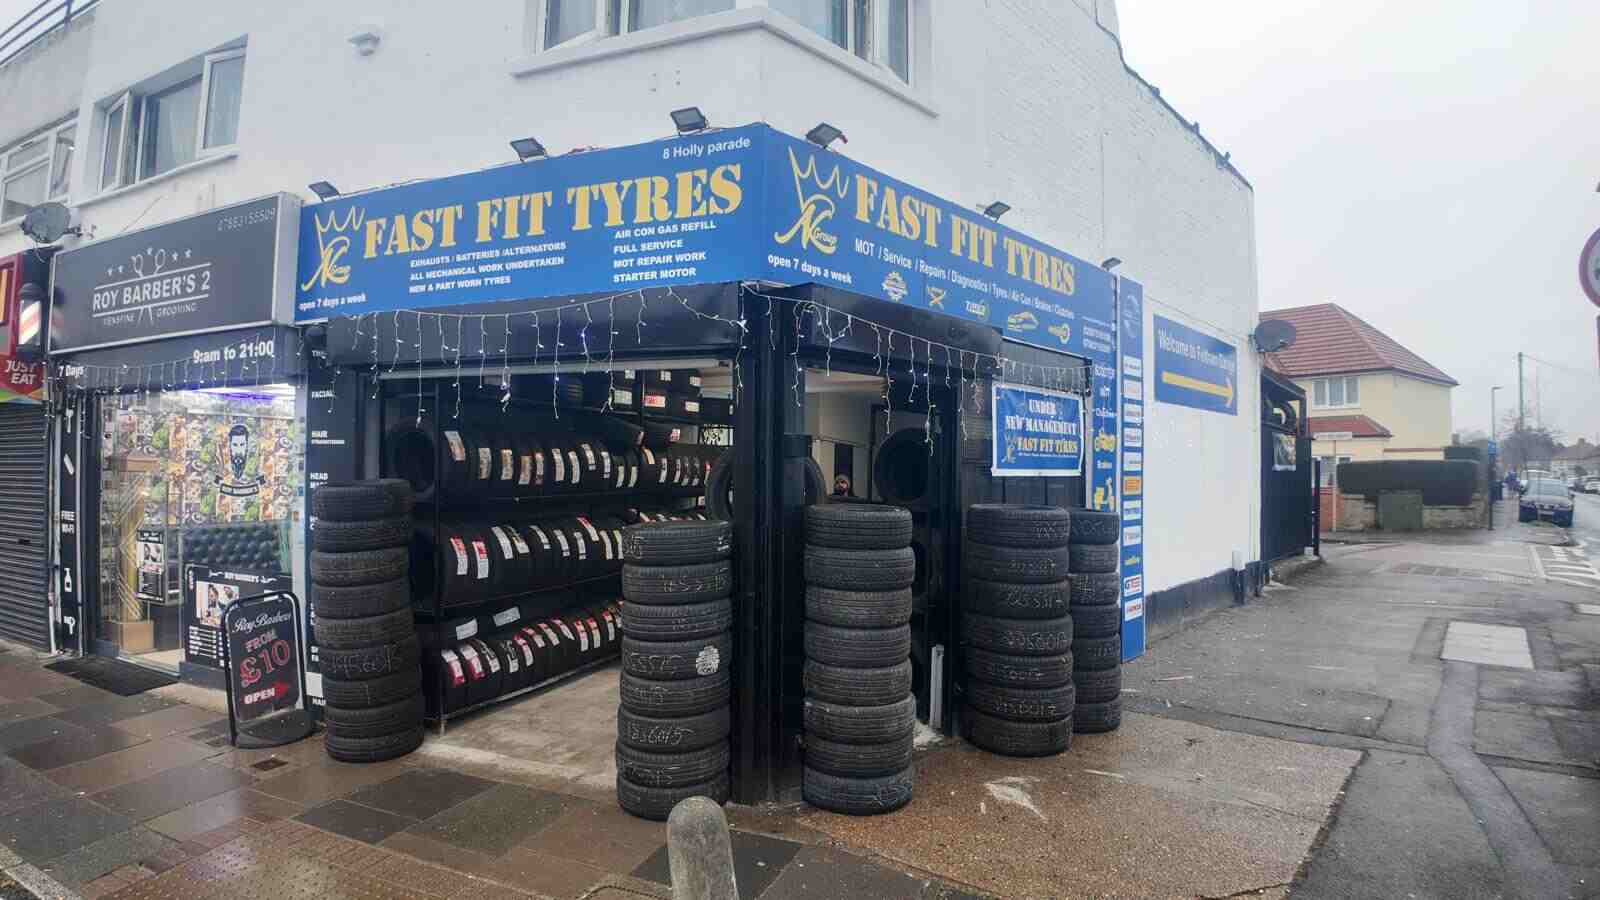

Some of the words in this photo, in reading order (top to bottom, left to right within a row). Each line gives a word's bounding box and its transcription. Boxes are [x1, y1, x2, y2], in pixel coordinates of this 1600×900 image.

[672, 143, 704, 158] Holly
[707, 136, 751, 156] parade
[363, 205, 464, 259] FAST
[475, 190, 553, 243] FIT
[566, 163, 742, 231] TYRES
[614, 229, 631, 239] AIR
[633, 227, 656, 237] CON
[657, 223, 679, 234] GAS
[681, 219, 716, 232] REFILL
[855, 174, 941, 248] FAST
[950, 214, 998, 268] FIT
[1003, 235, 1075, 296] TYRES
[456, 249, 500, 262] BATTERIES
[613, 243, 638, 254] FULL
[640, 239, 684, 251] SERVICE
[410, 272, 424, 281] ALL
[426, 266, 477, 278] MECHANICAL
[479, 263, 503, 273] WORK
[505, 256, 565, 270] UNDERTAKEN
[613, 258, 635, 269] MOT
[636, 255, 673, 266] REPAIR
[674, 251, 706, 262] WORK
[767, 254, 791, 268] open
[793, 257, 800, 270] 7
[801, 260, 822, 277] days
[823, 268, 829, 278] a
[831, 270, 852, 284] week
[855, 238, 875, 257] MOT
[883, 247, 912, 269] Service
[919, 259, 946, 281] Repairs
[435, 281, 456, 291] PART
[457, 278, 482, 289] WORN
[483, 275, 512, 286] TYRES
[613, 272, 658, 283] STARTER
[660, 267, 697, 279] MOTOR
[92, 289, 120, 311] ROY
[122, 273, 196, 305] BARBER'S
[201, 270, 210, 291] 2
[223, 346, 237, 361] to
[240, 340, 274, 359] 21:00
[1158, 328, 1189, 357] Welcome
[5, 360, 37, 373] JUST
[59, 365, 65, 377] 7
[65, 365, 85, 379] Days
[11, 373, 37, 384] EAT
[1028, 399, 1057, 416] UNDER
[1005, 415, 1024, 430] NEW
[245, 629, 278, 653] FROM
[240, 640, 290, 688] £10
[244, 687, 276, 704] OPEN
